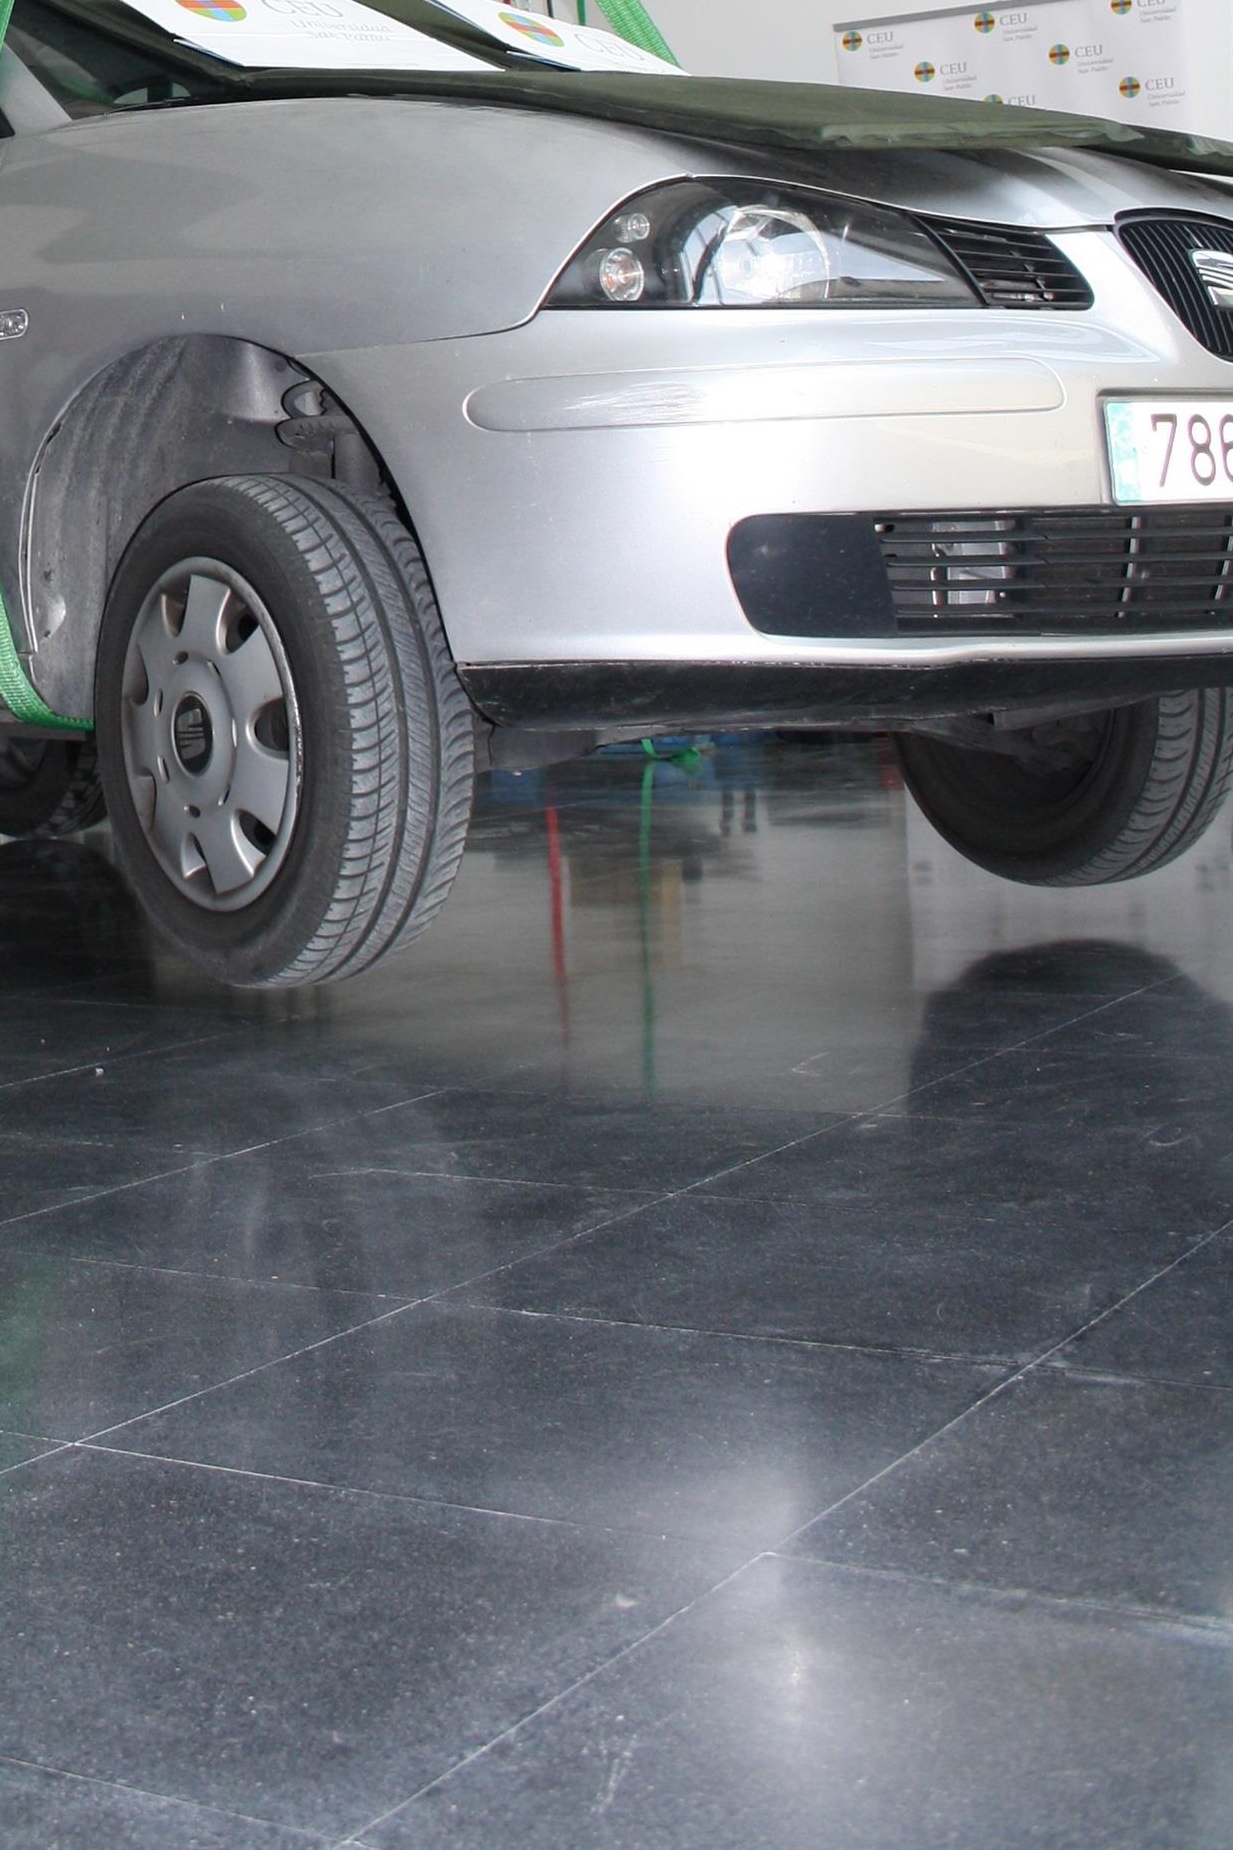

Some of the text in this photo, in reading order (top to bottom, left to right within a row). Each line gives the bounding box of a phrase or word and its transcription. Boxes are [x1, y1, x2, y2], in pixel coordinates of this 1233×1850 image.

[999, 13, 1028, 27] CEU
[867, 31, 894, 45] CEU
[1074, 44, 1104, 58] CEU
[939, 62, 968, 76] CEU
[1145, 77, 1175, 91] CEU
[1007, 95, 1036, 107] CEU
